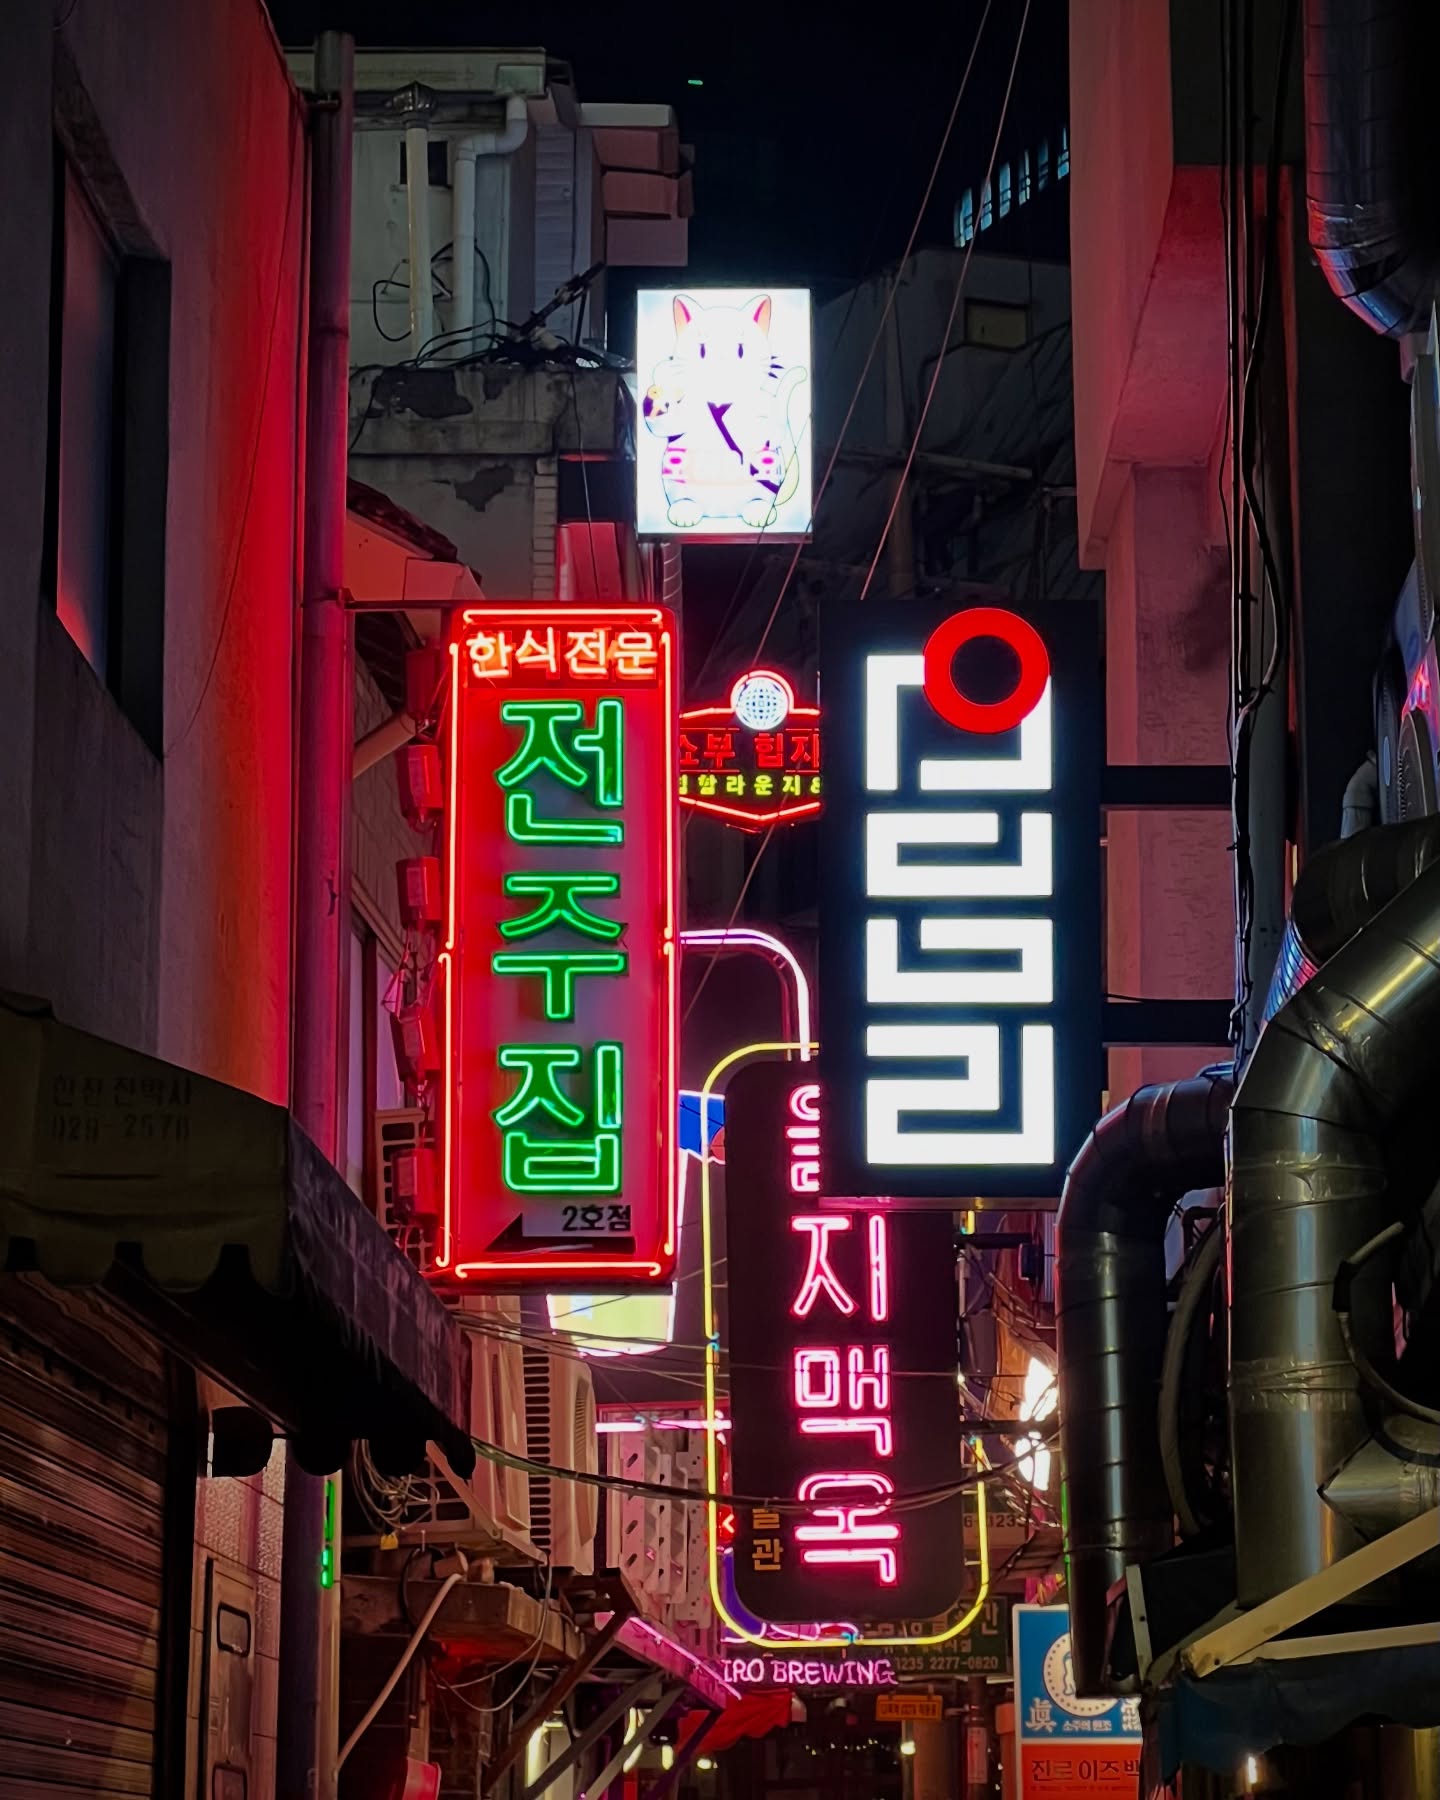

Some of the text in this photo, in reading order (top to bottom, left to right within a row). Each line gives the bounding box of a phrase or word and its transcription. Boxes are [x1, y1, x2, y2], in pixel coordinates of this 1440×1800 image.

[465, 626, 659, 679] 한식전문
[493, 699, 626, 1194] 전주집
[561, 1204, 632, 1233] 2호점
[770, 1658, 899, 1686] BREWING
